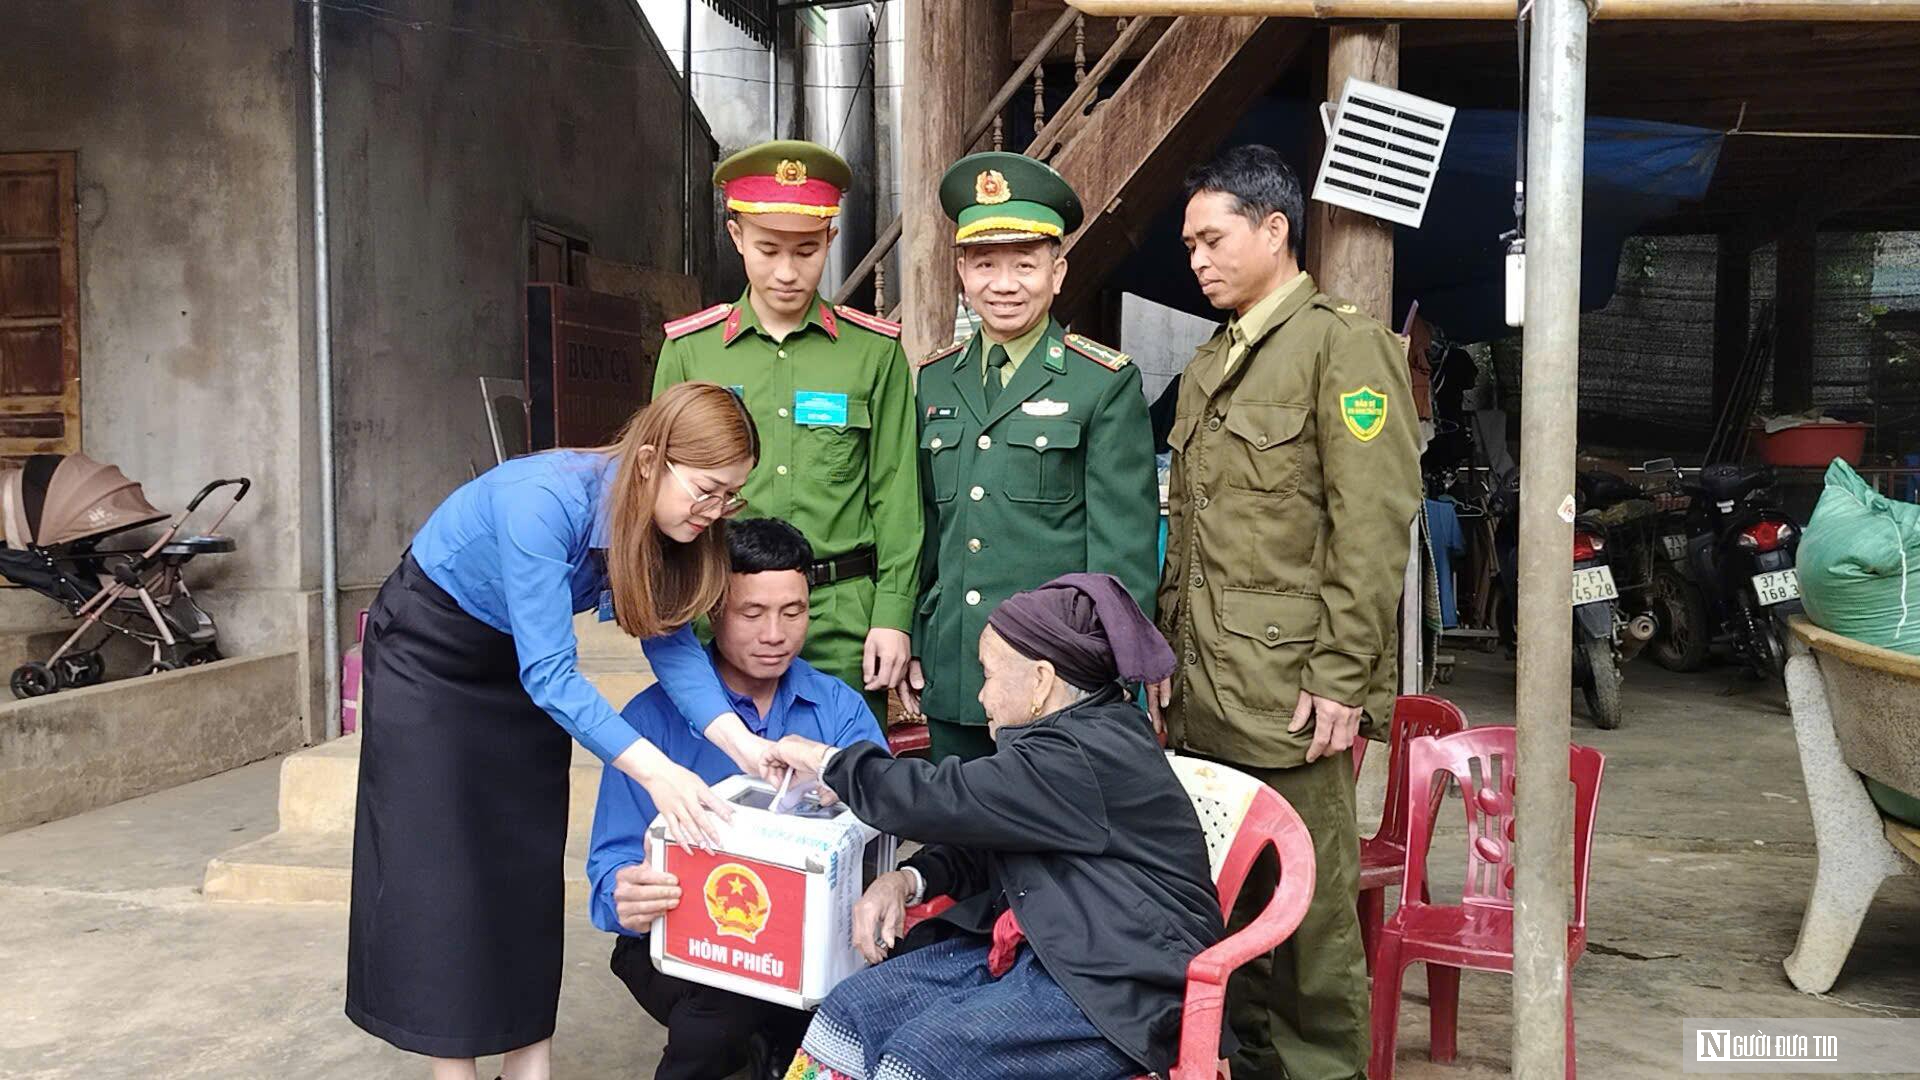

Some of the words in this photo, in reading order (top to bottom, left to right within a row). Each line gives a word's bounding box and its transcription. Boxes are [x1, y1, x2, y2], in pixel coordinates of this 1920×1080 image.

[1572, 570, 1604, 587] 7-F1
[1760, 571, 1798, 588] 37-F1
[689, 938, 728, 964] HÒM
[732, 949, 784, 978] PHIẾU
